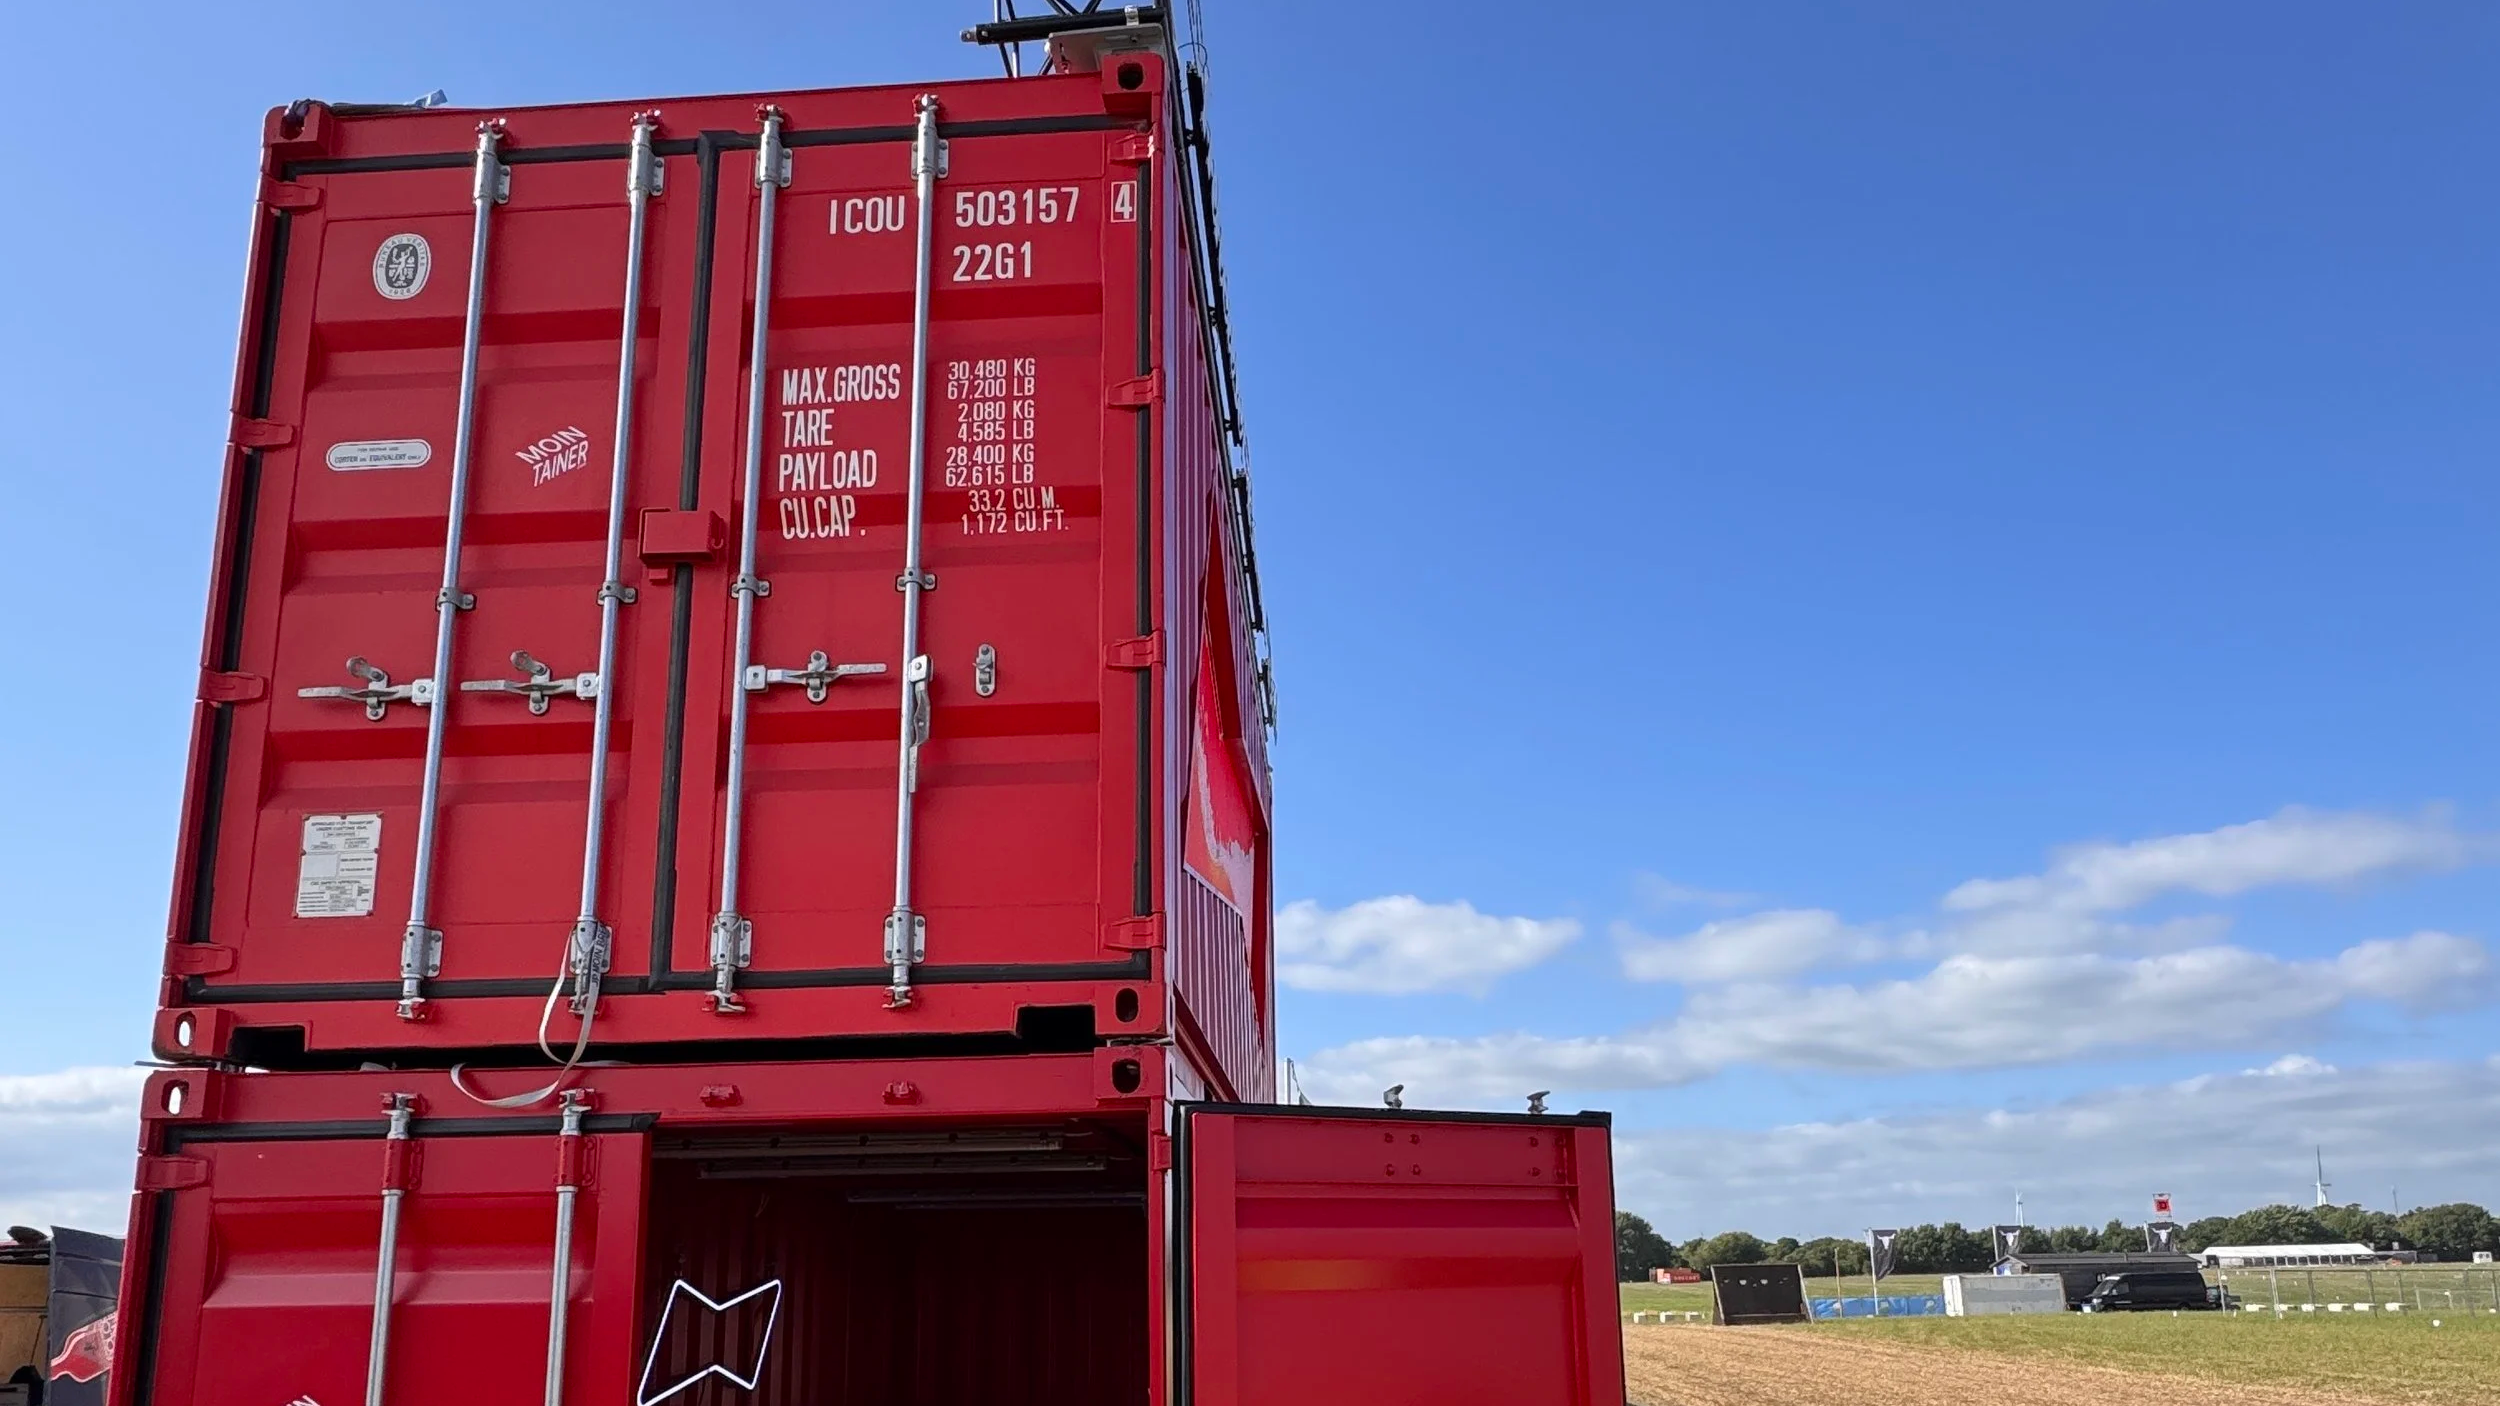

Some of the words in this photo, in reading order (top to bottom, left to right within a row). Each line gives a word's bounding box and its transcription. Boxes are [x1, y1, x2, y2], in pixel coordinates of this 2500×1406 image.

[829, 195, 905, 235] ICOU
[955, 186, 1080, 228] 503157
[1114, 183, 1134, 220] 4
[952, 241, 1032, 282] 22G1
[782, 363, 901, 406] MAX.GROSS
[948, 359, 1007, 380] 30,480
[1014, 358, 1035, 377] KG
[947, 378, 1006, 400] 67,200
[1013, 377, 1035, 396] LB
[781, 408, 835, 448] TARE
[958, 401, 1006, 422] 2,080
[1013, 399, 1035, 420] KG
[958, 421, 1006, 443] 4,585
[1013, 420, 1034, 440] LB
[515, 425, 588, 464] MOIN
[533, 440, 588, 487] TAINER
[778, 449, 878, 493] PAYLOAD
[946, 444, 1005, 467] 28,400
[1012, 443, 1035, 463] KG
[945, 464, 1005, 487] 62,615
[1012, 463, 1034, 484] LB
[968, 488, 1007, 512] 33.2
[1012, 486, 1060, 510] CU.M.
[961, 512, 1007, 535] 1,172
[1014, 509, 1069, 532] CU.FT.
